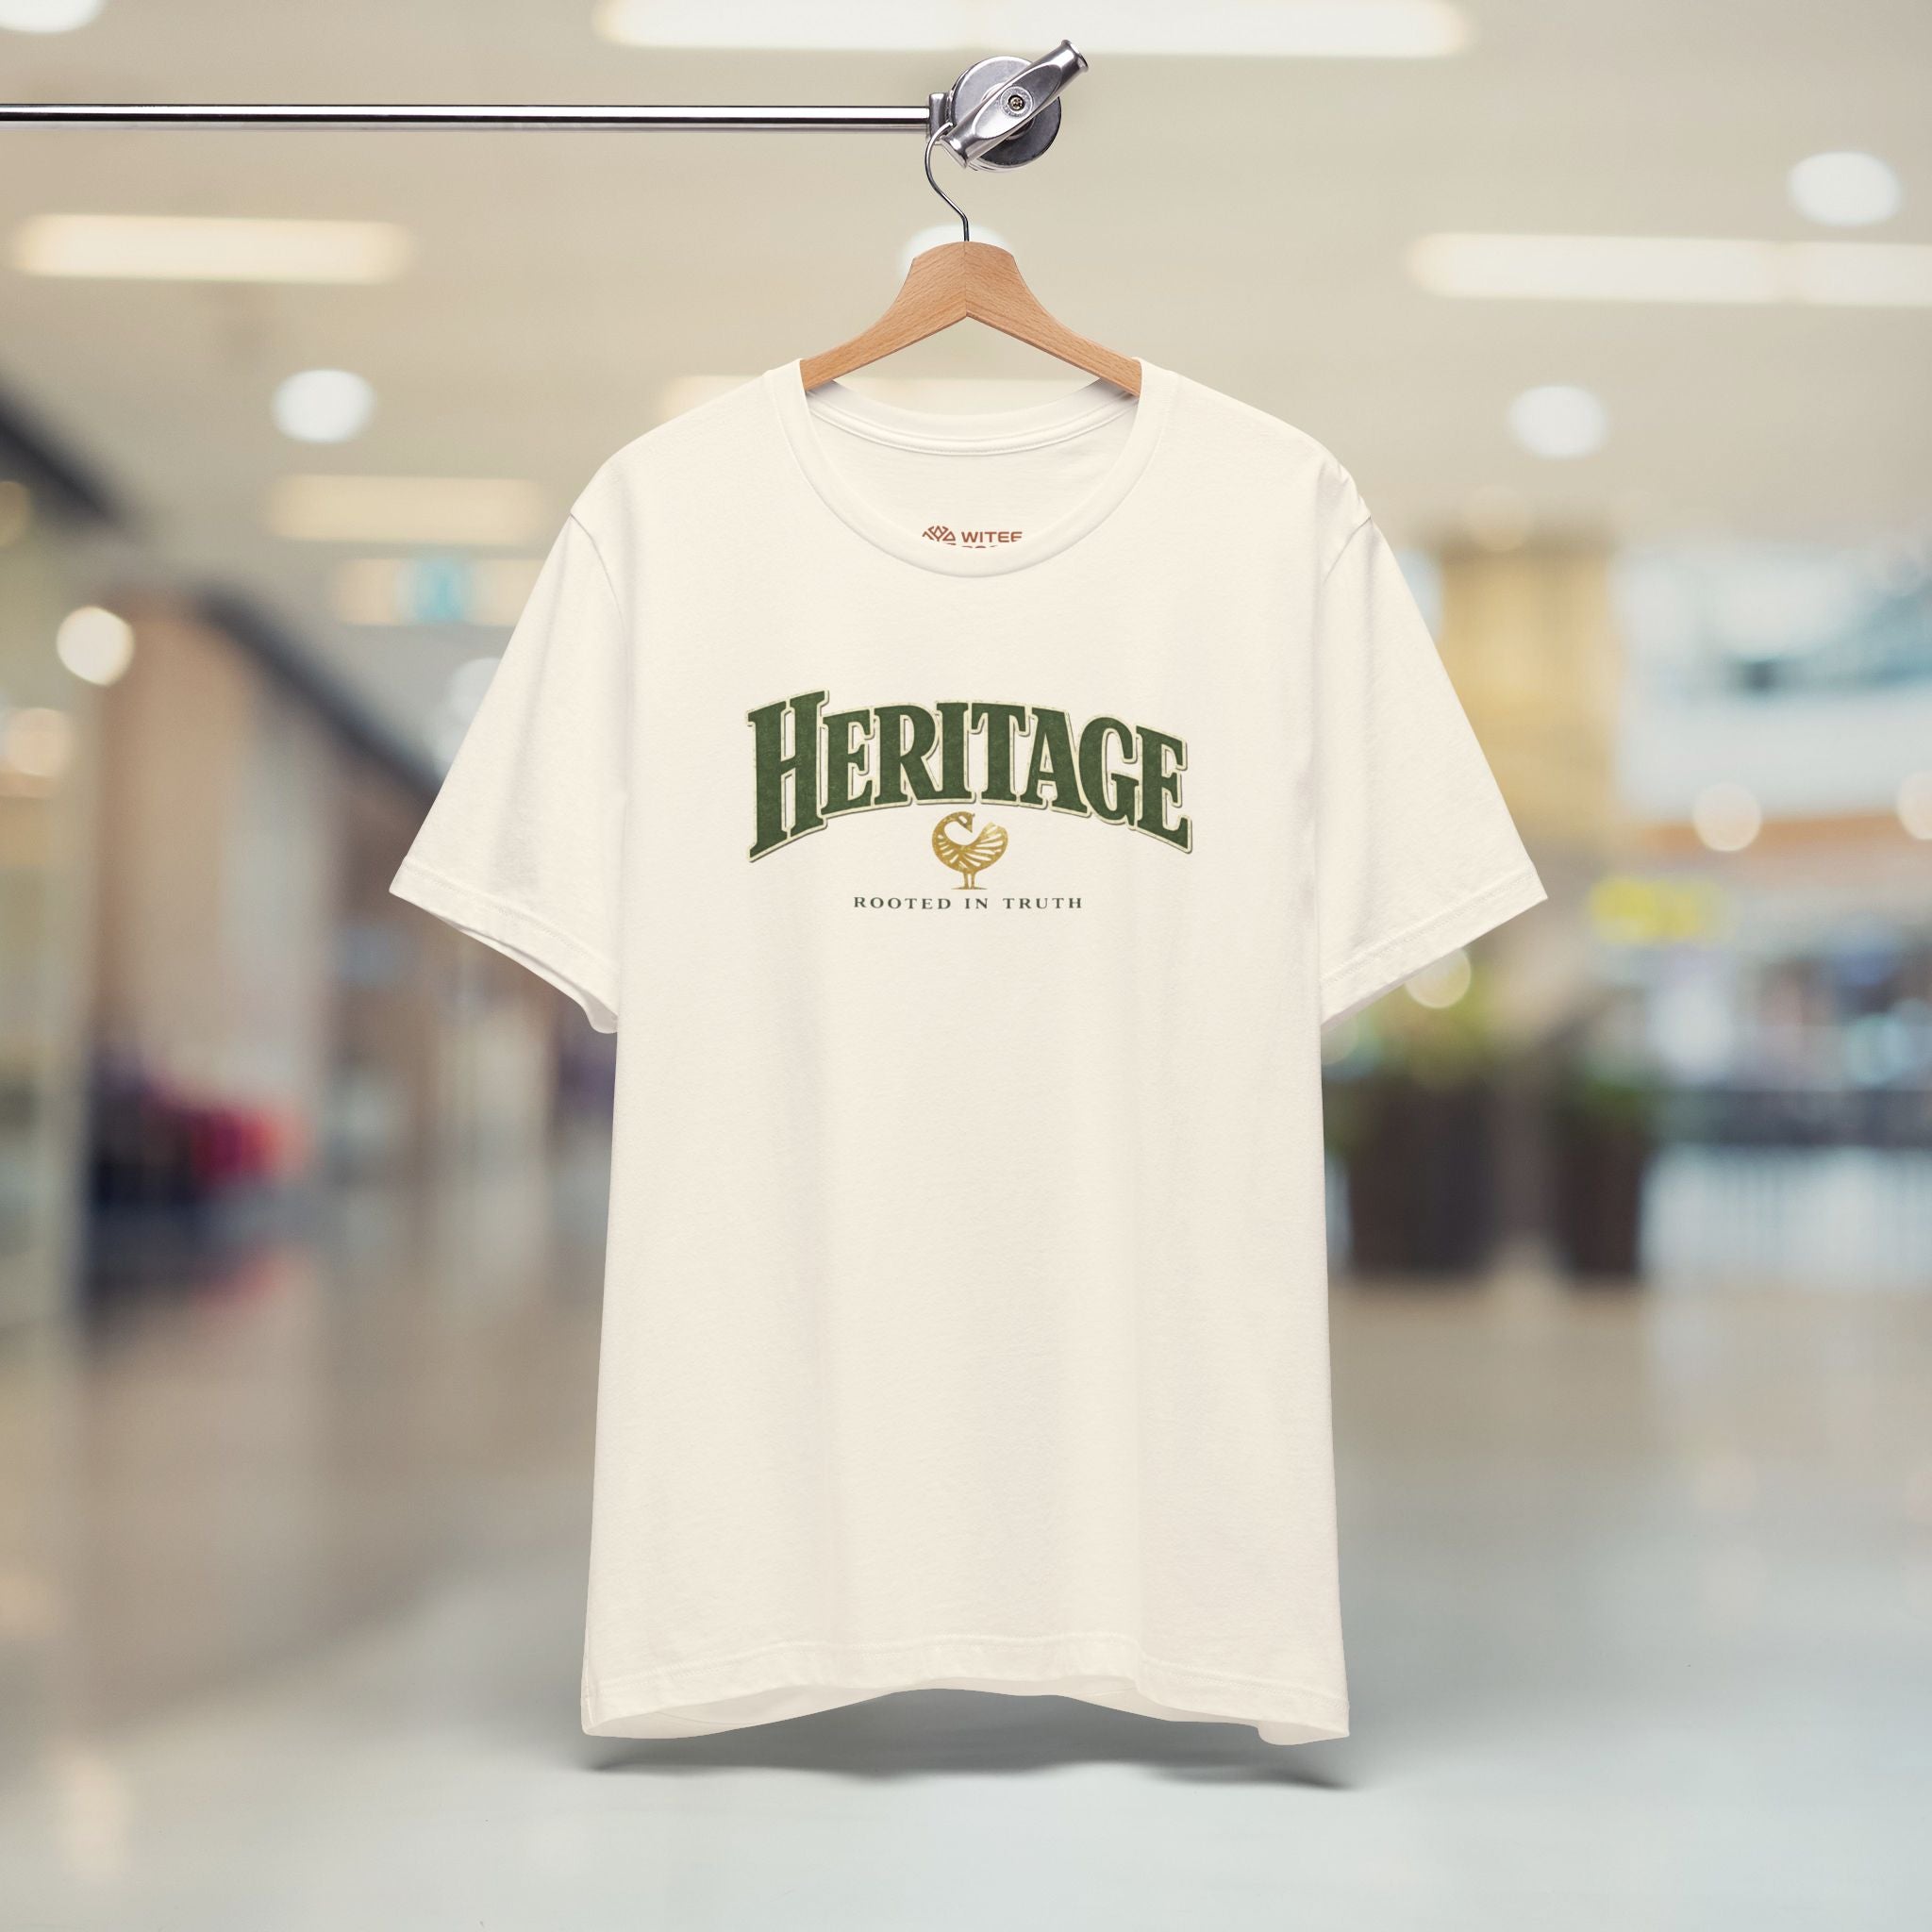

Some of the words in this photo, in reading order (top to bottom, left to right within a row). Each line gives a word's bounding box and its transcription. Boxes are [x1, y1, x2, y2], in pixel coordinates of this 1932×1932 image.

[748, 689, 1194, 863] HERITAGE
[853, 896, 952, 910] ROOTED
[964, 896, 989, 910] IN
[1002, 896, 1083, 910] TRUTH
